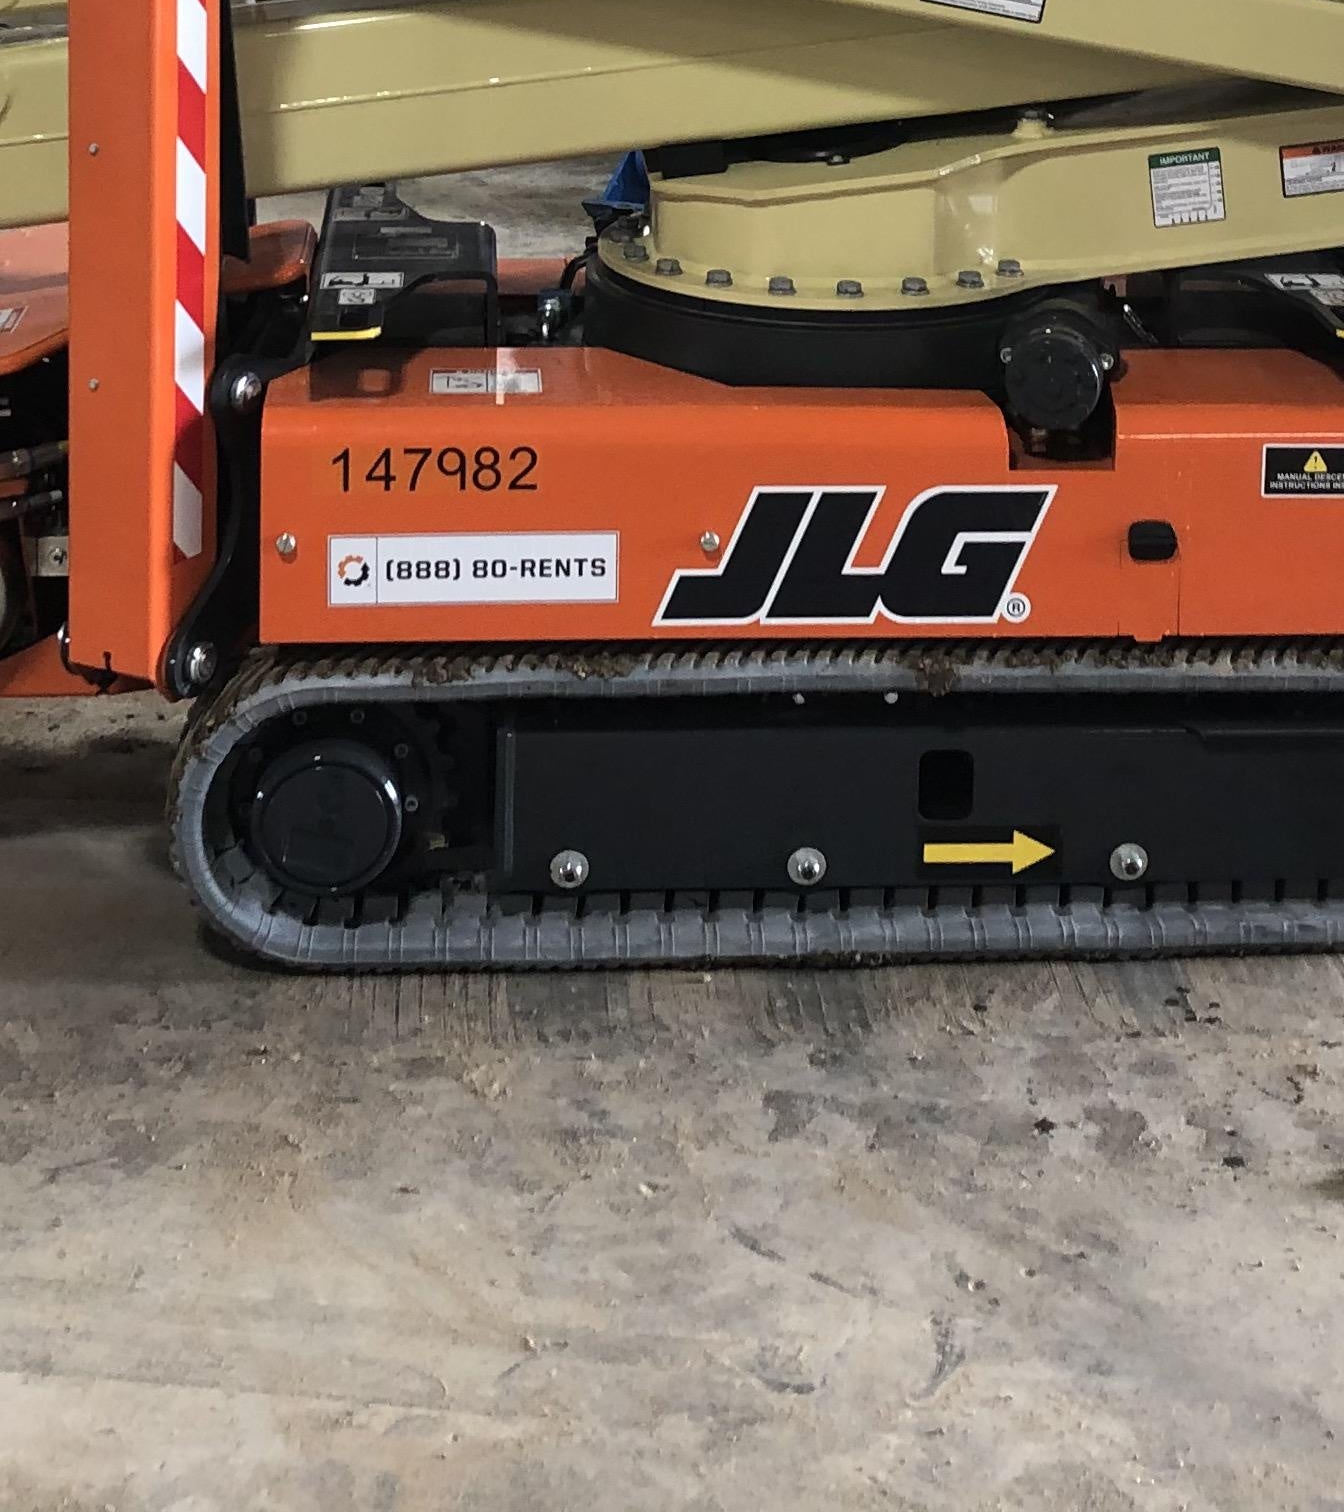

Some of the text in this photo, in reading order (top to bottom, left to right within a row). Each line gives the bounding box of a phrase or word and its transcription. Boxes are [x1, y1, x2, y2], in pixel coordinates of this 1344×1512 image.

[1159, 152, 1210, 165] IMPORTANT
[331, 446, 538, 492] 147982
[1277, 473, 1312, 481] MANUAL
[651, 485, 1058, 626] JLG
[386, 558, 607, 582] (888) 80-RENTS
